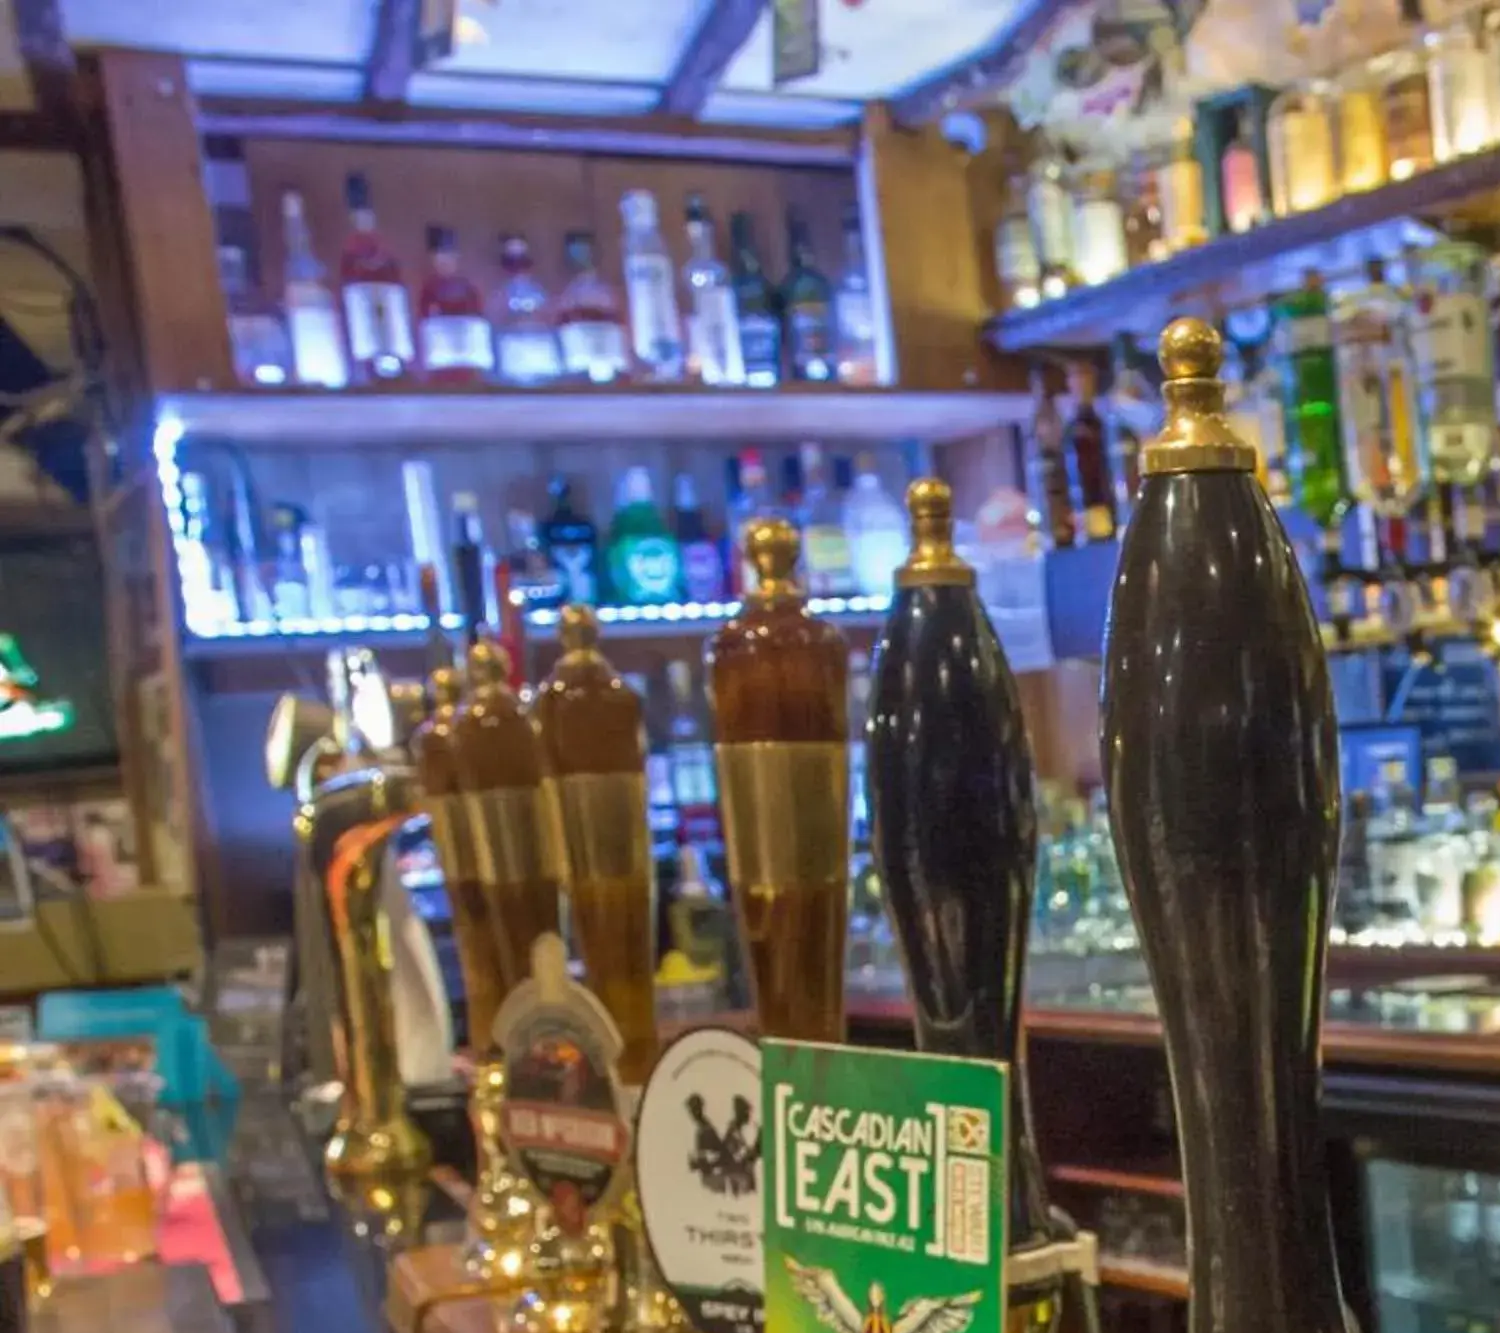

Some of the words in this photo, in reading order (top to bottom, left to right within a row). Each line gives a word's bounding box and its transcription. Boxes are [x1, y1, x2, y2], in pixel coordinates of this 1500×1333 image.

[787, 1101, 933, 1156] CASCADIAN
[795, 1139, 929, 1230] EAST
[685, 1223, 763, 1250] THIRS
